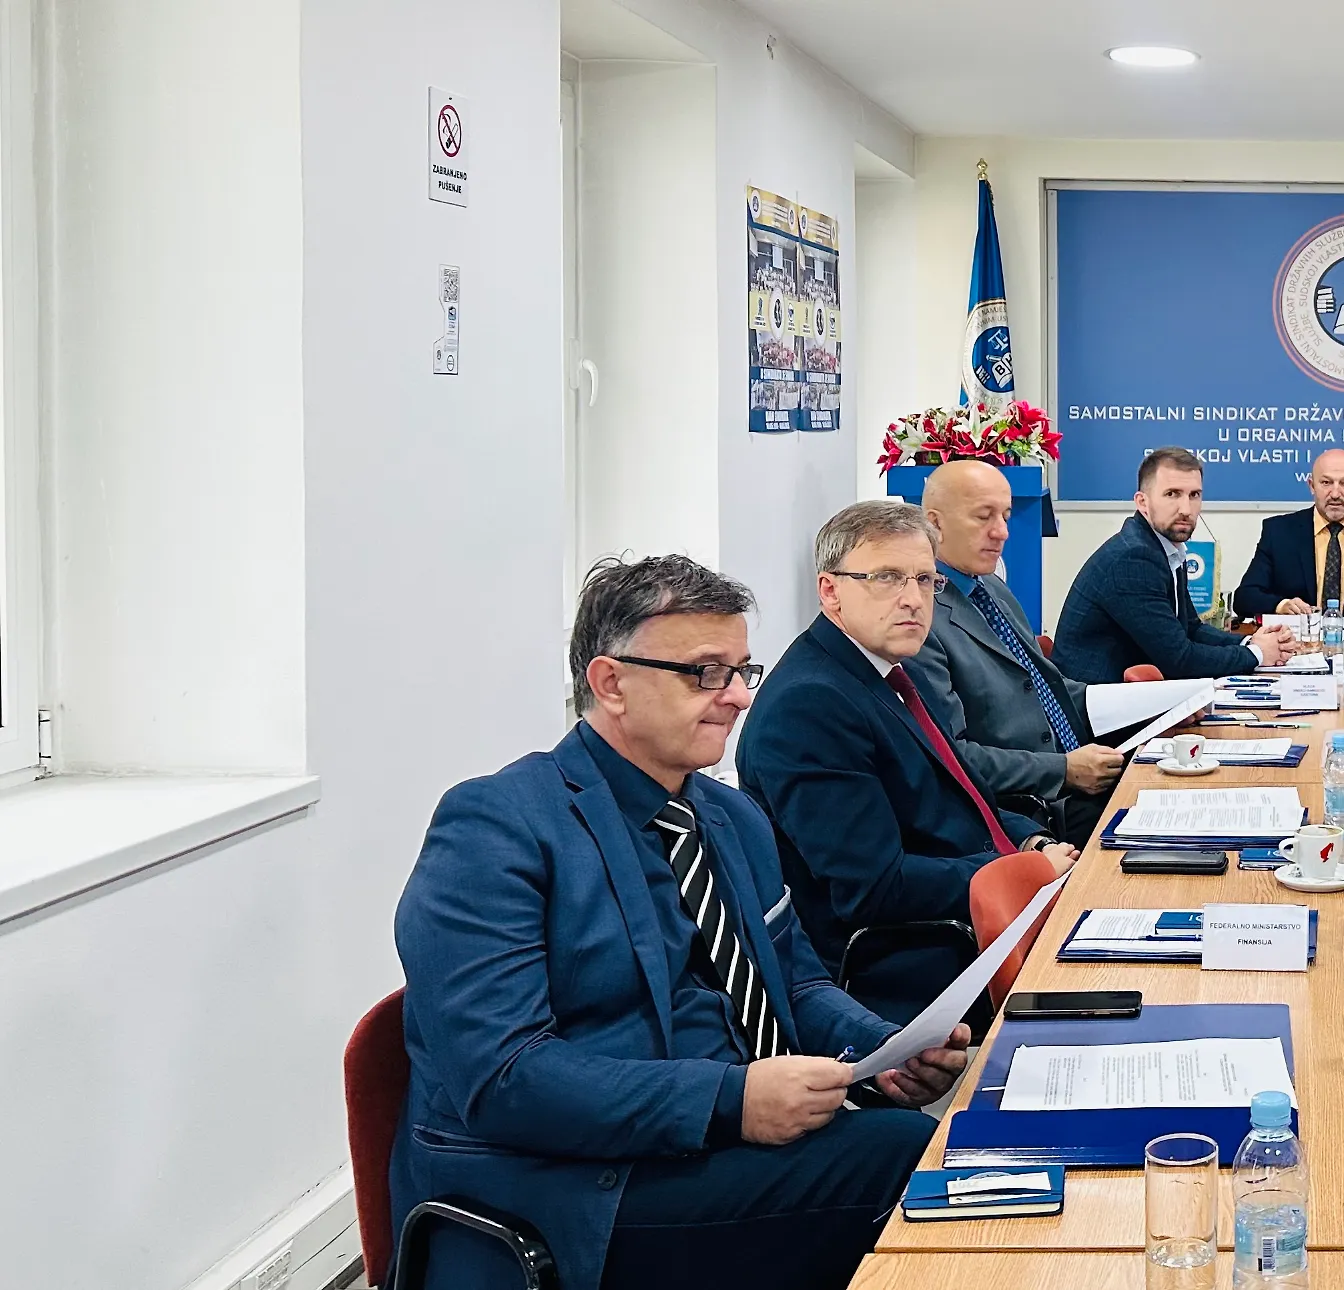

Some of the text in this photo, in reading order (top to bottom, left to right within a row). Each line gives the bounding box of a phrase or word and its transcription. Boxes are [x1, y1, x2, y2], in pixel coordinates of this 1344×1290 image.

[432, 164, 467, 181] ZABRANJENO
[438, 180, 462, 194] PUŠENJE
[1287, 249, 1316, 292] DRŽAVNIH
[1299, 264, 1319, 307] SUDSKOJ
[1287, 297, 1305, 341] SINDIKAT
[1069, 406, 1185, 421] SAMOSTALNI
[1193, 406, 1278, 421] SINDIKAT
[1219, 429, 1229, 442] U
[1238, 428, 1335, 442] ORGANIMA
[1238, 449, 1298, 463] VLASTI
[1306, 450, 1311, 463] I
[1209, 922, 1250, 930] FEDERALNO
